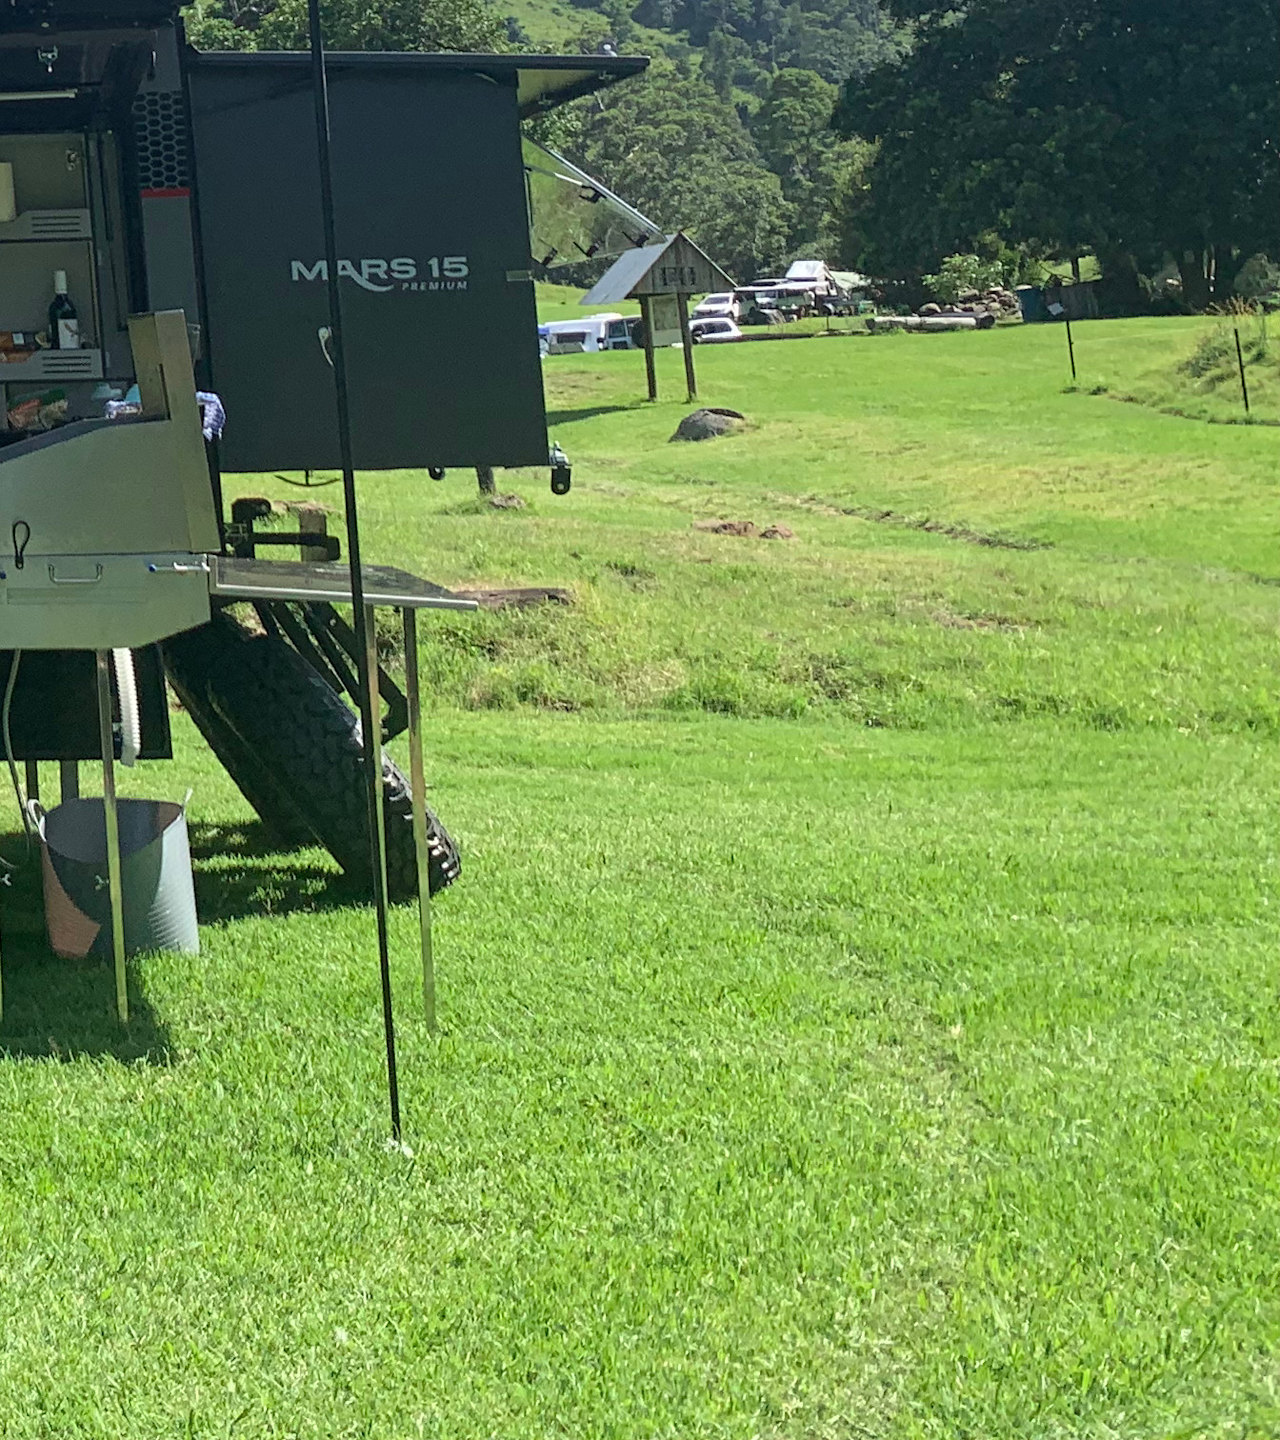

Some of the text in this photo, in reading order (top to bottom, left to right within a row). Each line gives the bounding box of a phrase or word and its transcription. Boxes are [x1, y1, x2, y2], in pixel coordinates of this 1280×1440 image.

[291, 256, 469, 292] MARS 15
[401, 281, 468, 291] PREMIUM
